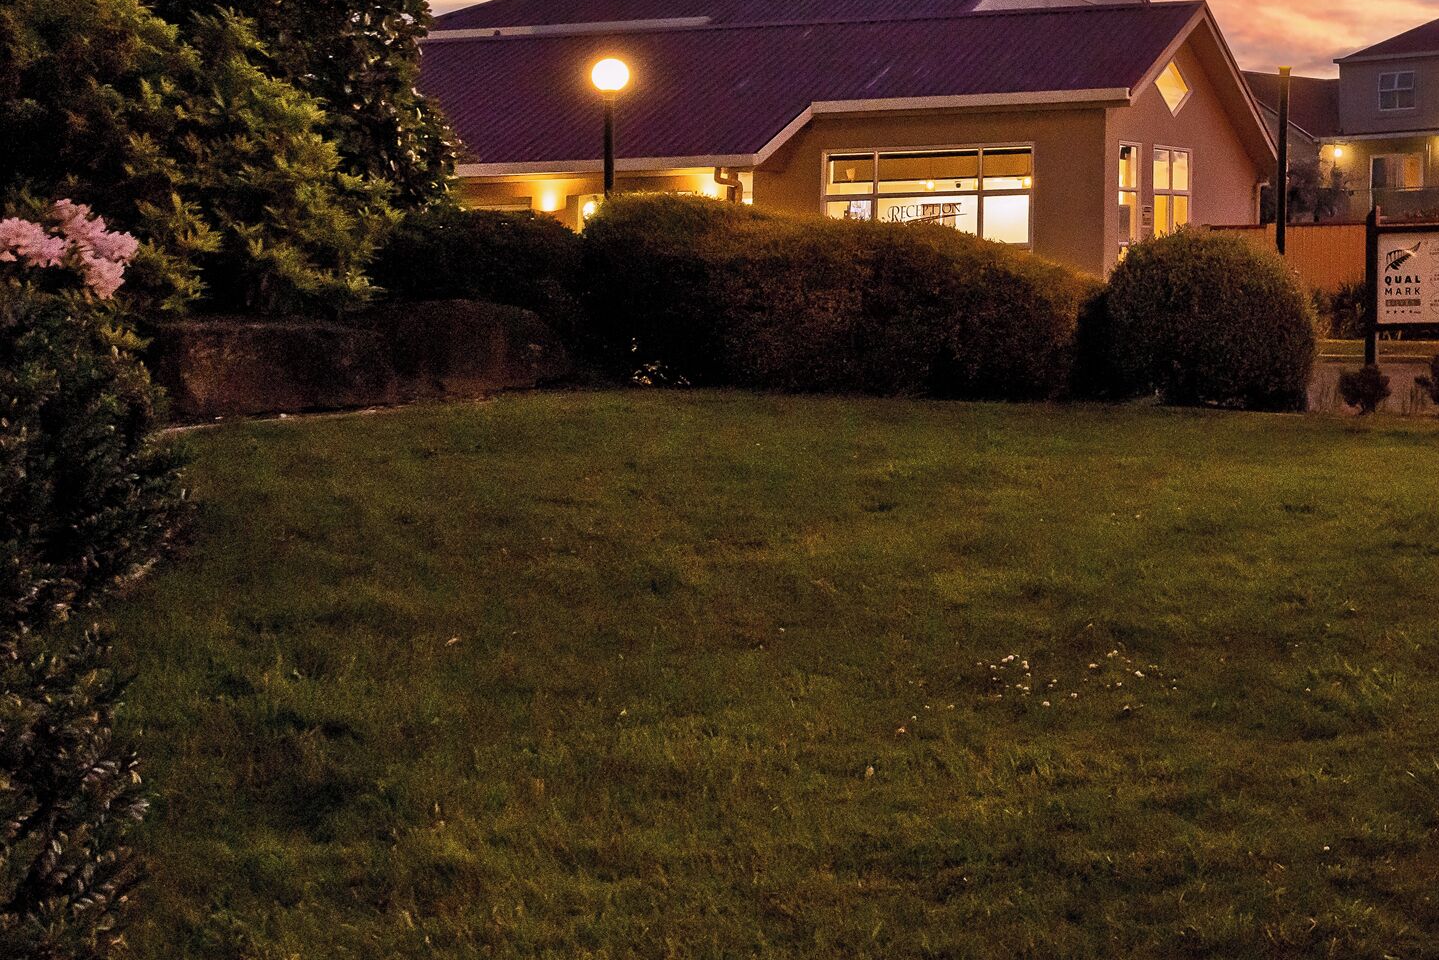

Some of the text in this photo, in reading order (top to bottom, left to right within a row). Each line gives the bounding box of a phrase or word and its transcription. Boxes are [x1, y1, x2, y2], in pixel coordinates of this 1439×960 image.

[888, 203, 961, 222] RECEPTION
[1385, 275, 1421, 286] QUAL
[1385, 287, 1421, 296] MARK
